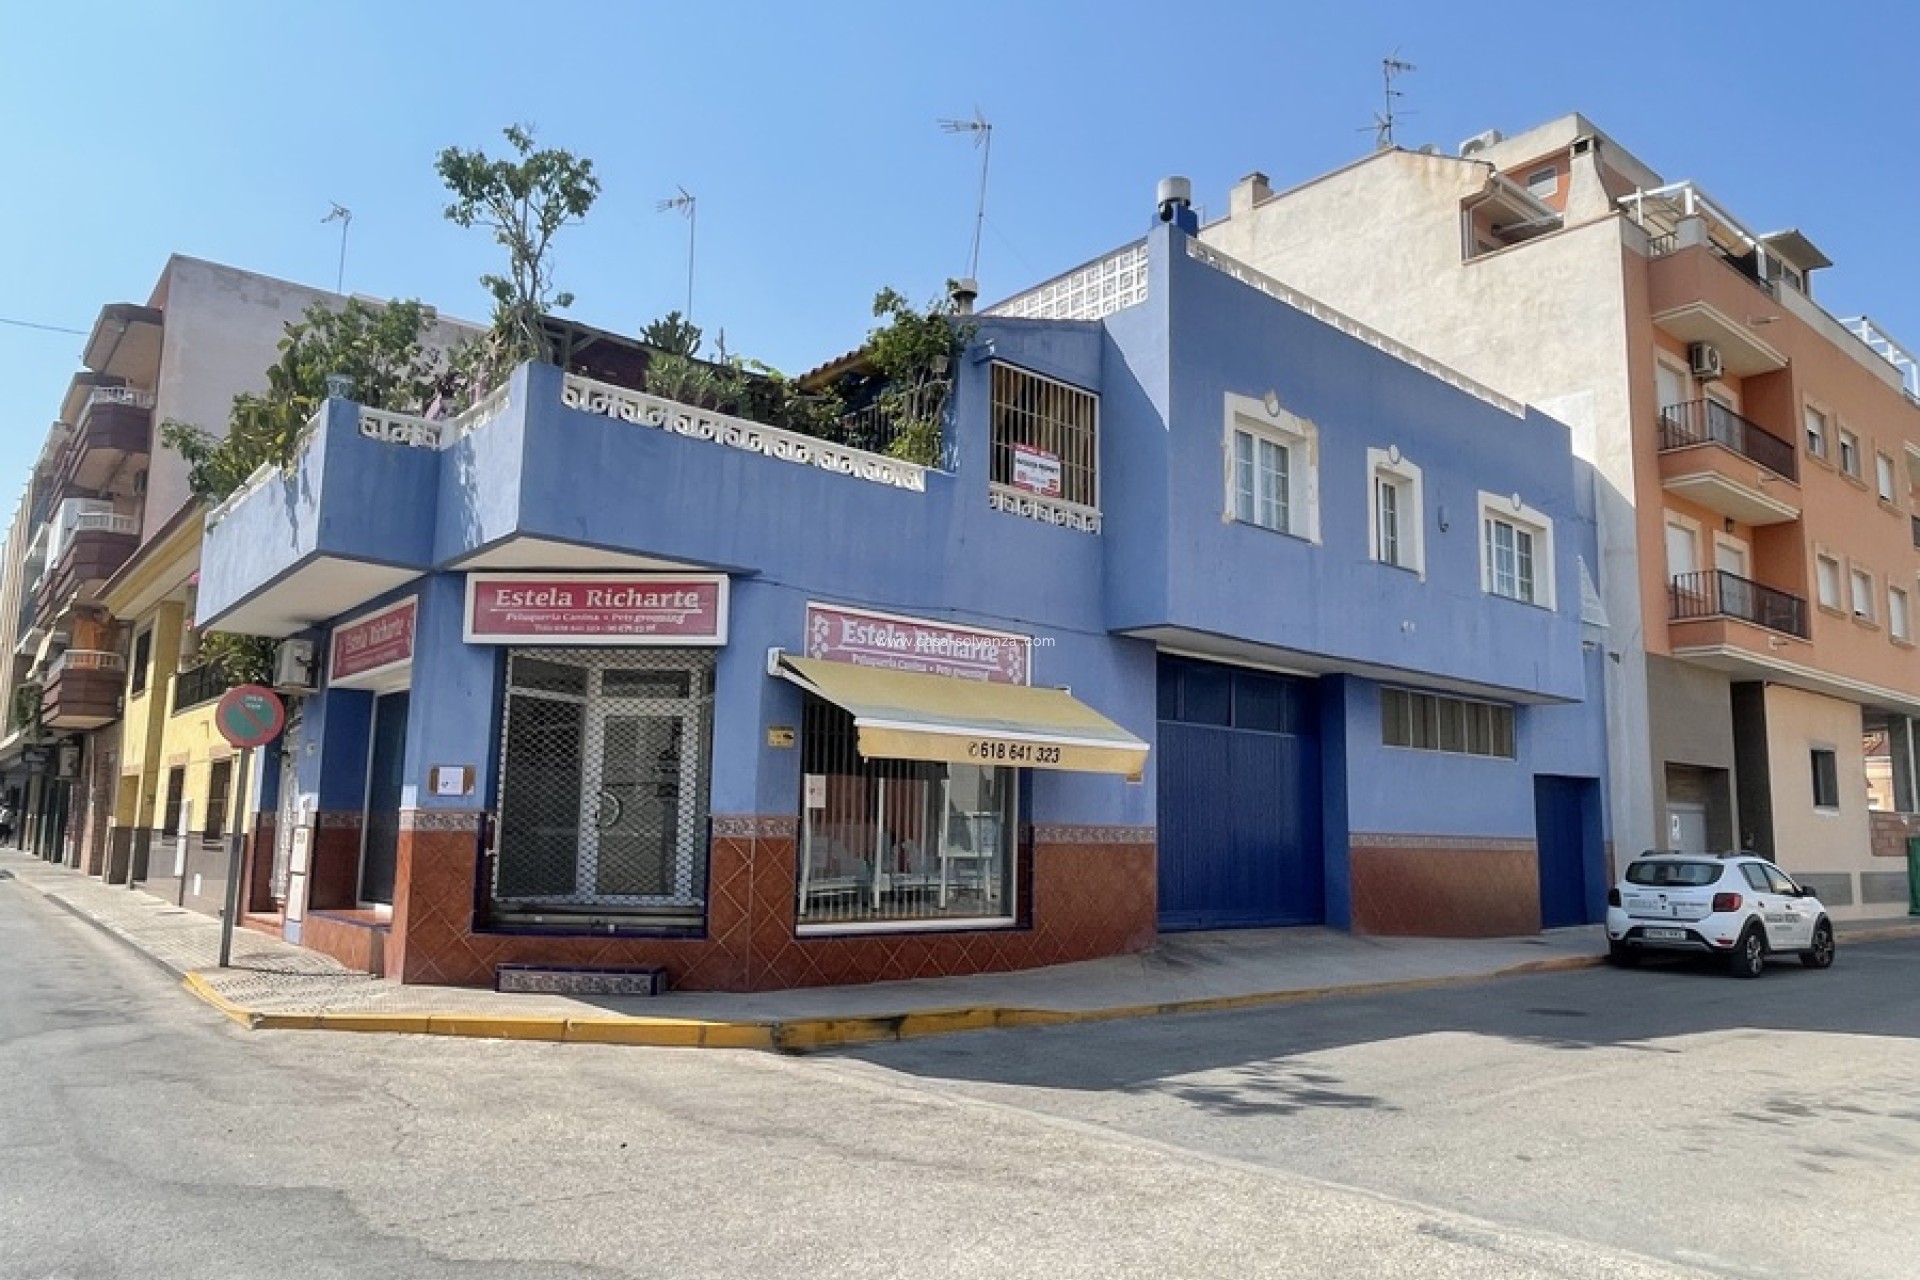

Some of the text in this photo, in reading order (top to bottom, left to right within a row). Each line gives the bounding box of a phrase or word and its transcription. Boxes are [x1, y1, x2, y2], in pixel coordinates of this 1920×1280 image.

[496, 587, 699, 609] Estela Richarte
[841, 618, 998, 663] Estela Richarte
[980, 741, 1061, 764] 618 641 323
